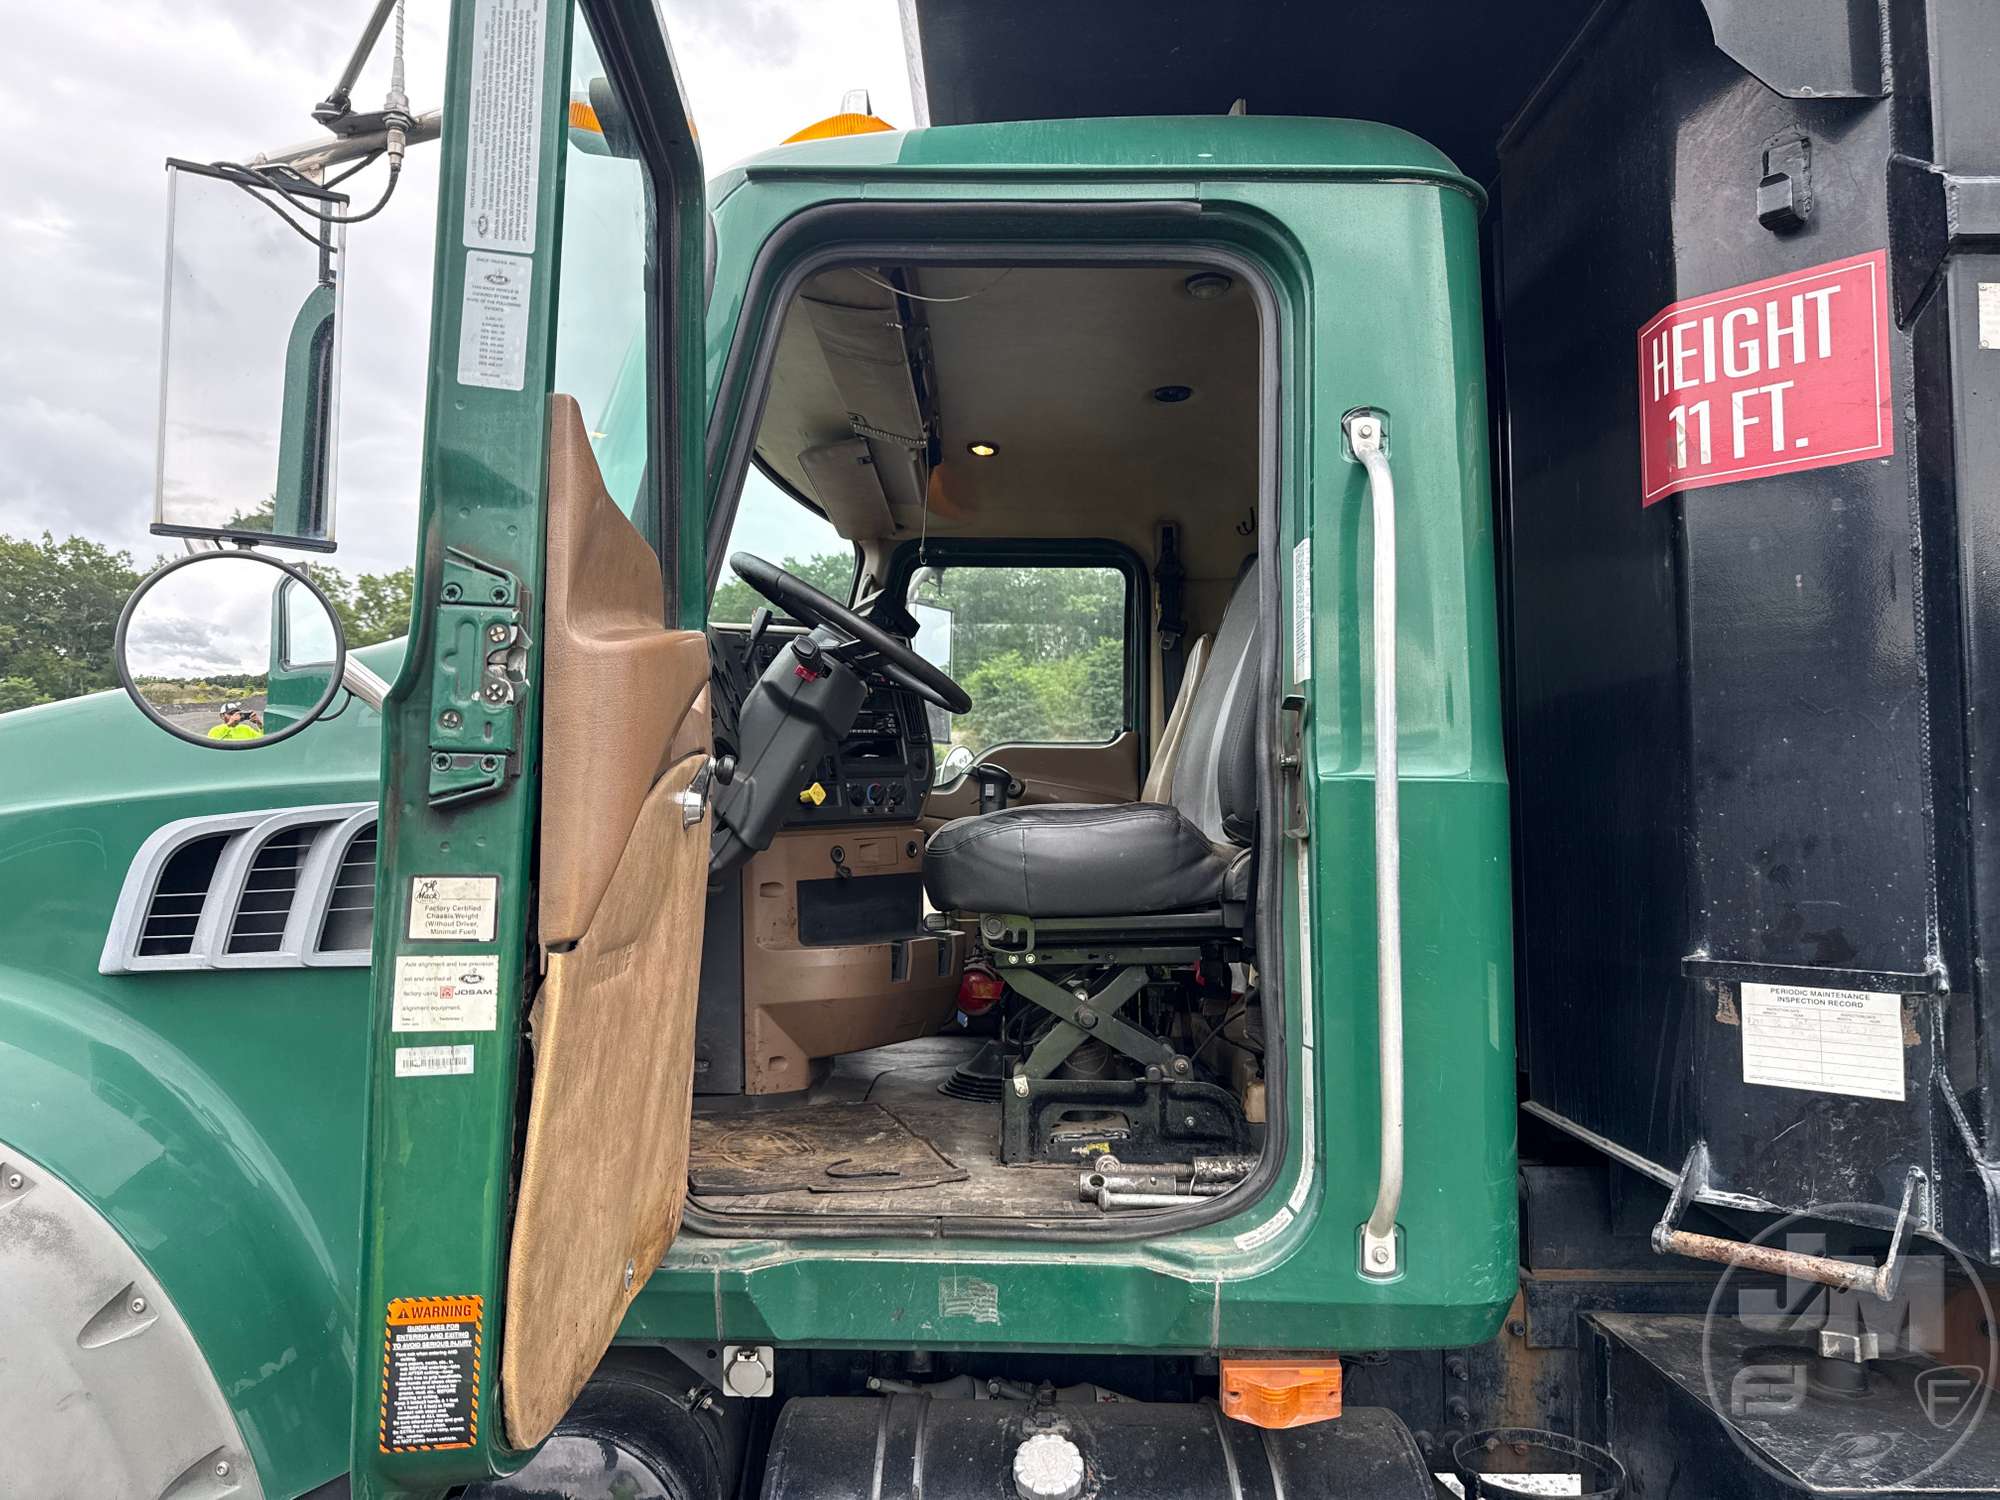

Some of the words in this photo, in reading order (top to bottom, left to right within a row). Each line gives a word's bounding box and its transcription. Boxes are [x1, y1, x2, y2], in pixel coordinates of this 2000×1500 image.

[1652, 285, 1841, 402] HEIGHT
[1668, 400, 1711, 469] 11
[1731, 380, 1808, 459] FT.
[455, 912, 479, 920] Weight
[425, 920, 455, 928] (Without
[456, 920, 479, 928] Driver,
[458, 928, 477, 936] Fuel)
[1770, 987, 1808, 996] PERIODIC
[1810, 990, 1871, 1001] MAINTENANCE
[1776, 996, 1826, 1005] INSPECTION
[1828, 999, 1864, 1008] RECORD
[411, 1304, 472, 1319] WARNING
